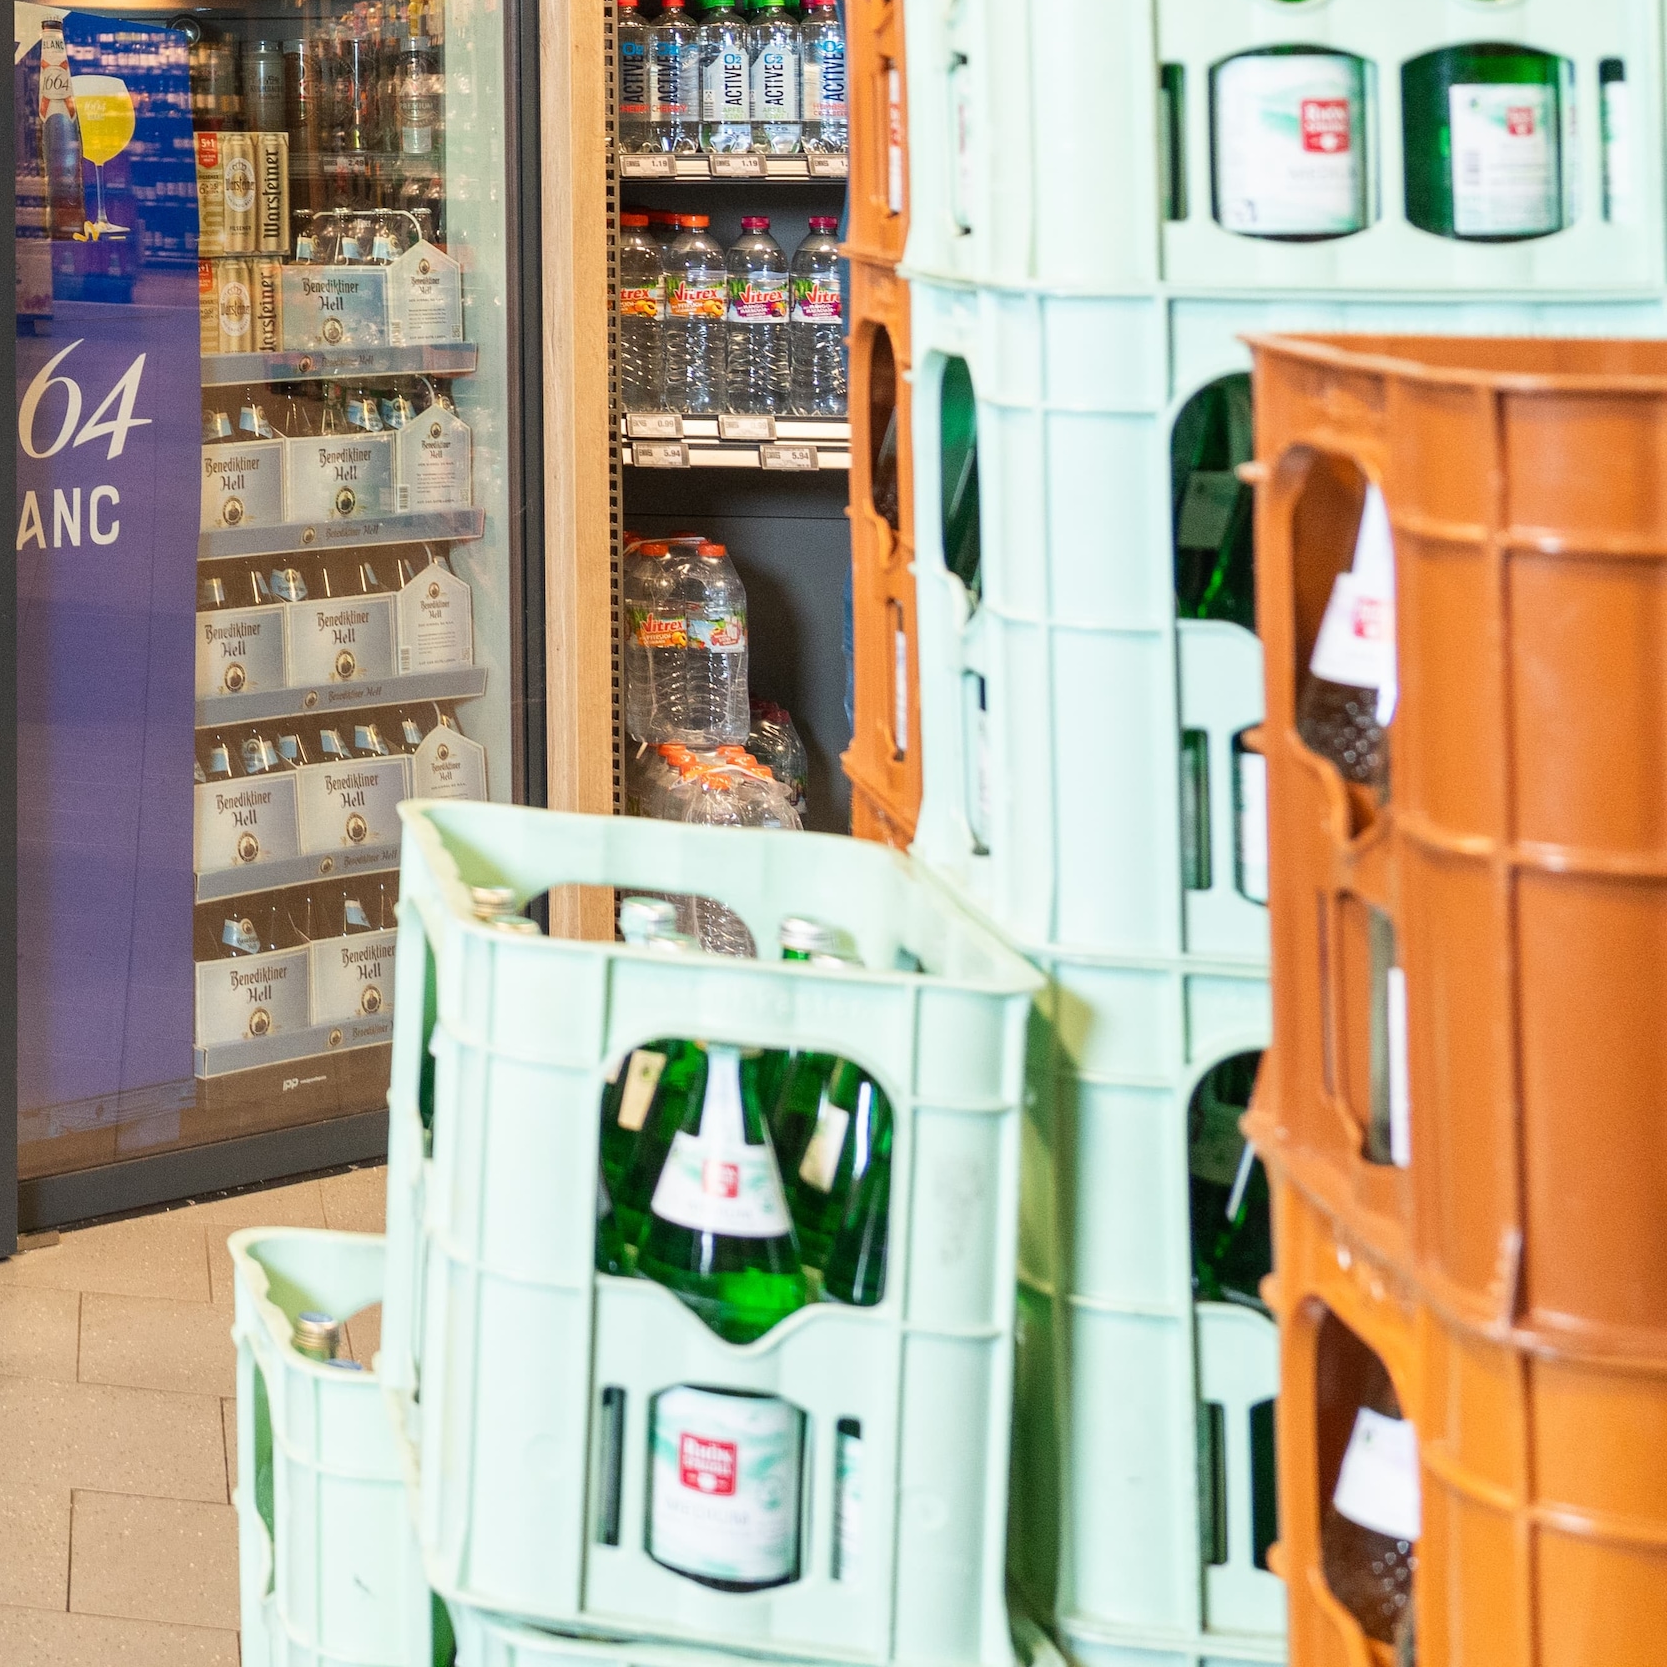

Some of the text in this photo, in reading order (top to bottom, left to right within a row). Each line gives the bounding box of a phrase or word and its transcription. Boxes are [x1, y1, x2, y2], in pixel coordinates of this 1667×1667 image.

[723, 53, 742, 64] O2
[725, 64, 742, 106] ACTIVE
[764, 63, 783, 106] ACTIVE
[823, 52, 845, 103] ACTIVE
[650, 160, 668, 168] 1.19
[740, 159, 758, 168] 1.19
[263, 150, 281, 239] Warsteiner
[302, 277, 359, 293] Benediktiner
[673, 281, 708, 301] Vitrex
[739, 282, 783, 302] Vitrex
[318, 296, 344, 312] Hell
[18, 338, 152, 461] 64
[318, 446, 372, 468] Benediktiner
[791, 451, 810, 460] 5.94
[204, 455, 260, 478] Benediktiner
[334, 463, 358, 481] Hell
[220, 473, 246, 491] Hell
[317, 609, 370, 632] Benediktiner
[640, 613, 684, 632] Vitrex
[205, 620, 261, 644] Benediktiner
[332, 625, 356, 645] Hell
[220, 639, 246, 658] Hell
[324, 771, 379, 794] Benediktiner
[216, 790, 272, 814] Benediktiner
[340, 789, 366, 808] Hell
[231, 808, 259, 828] Hell
[229, 963, 288, 992] Benediktiner
[357, 961, 382, 982] Hell
[245, 984, 272, 1004] Hell
